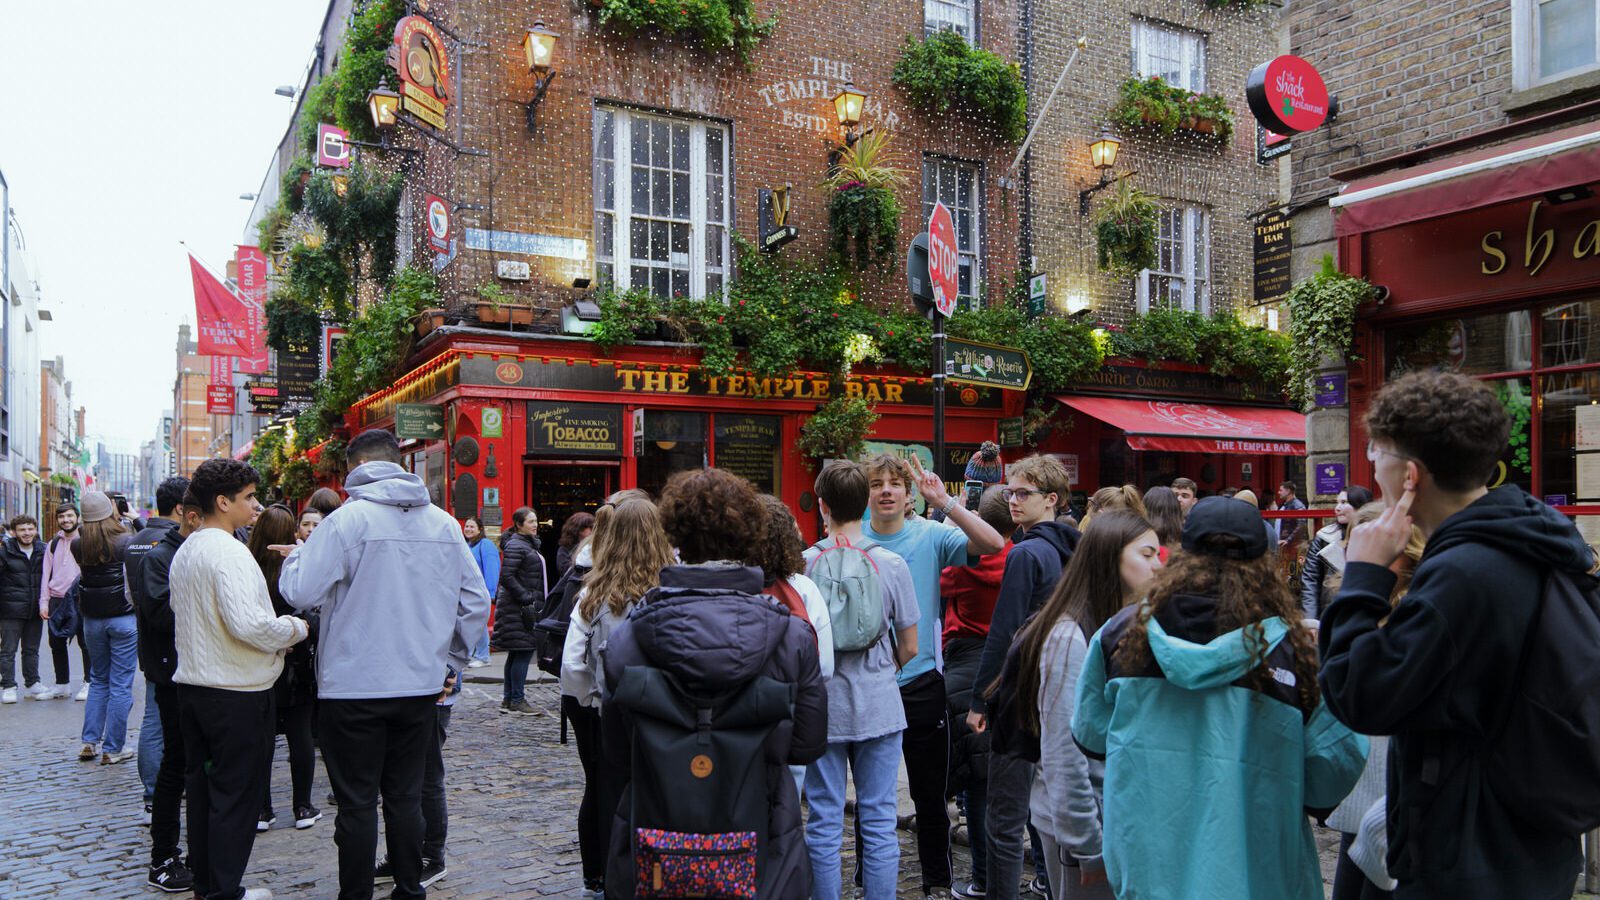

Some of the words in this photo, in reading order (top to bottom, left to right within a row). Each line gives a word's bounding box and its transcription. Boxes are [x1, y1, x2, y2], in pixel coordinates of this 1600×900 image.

[809, 56, 853, 83] THE
[1264, 233, 1284, 244] BAR
[930, 233, 956, 283] STOP
[244, 264, 254, 286] BAR
[201, 327, 246, 338] TEMPLE
[500, 366, 517, 378] 48
[996, 355, 1023, 378] Reserve
[616, 369, 690, 393] THE
[705, 374, 830, 399] TEMPLE
[846, 381, 904, 402] BAR
[580, 419, 609, 427] SMOKING
[725, 424, 758, 434] TEMPLE
[759, 426, 775, 437] BAR
[1215, 440, 1235, 450] THE
[1237, 441, 1272, 452] TEMPLE
[1274, 443, 1291, 453] BAR
